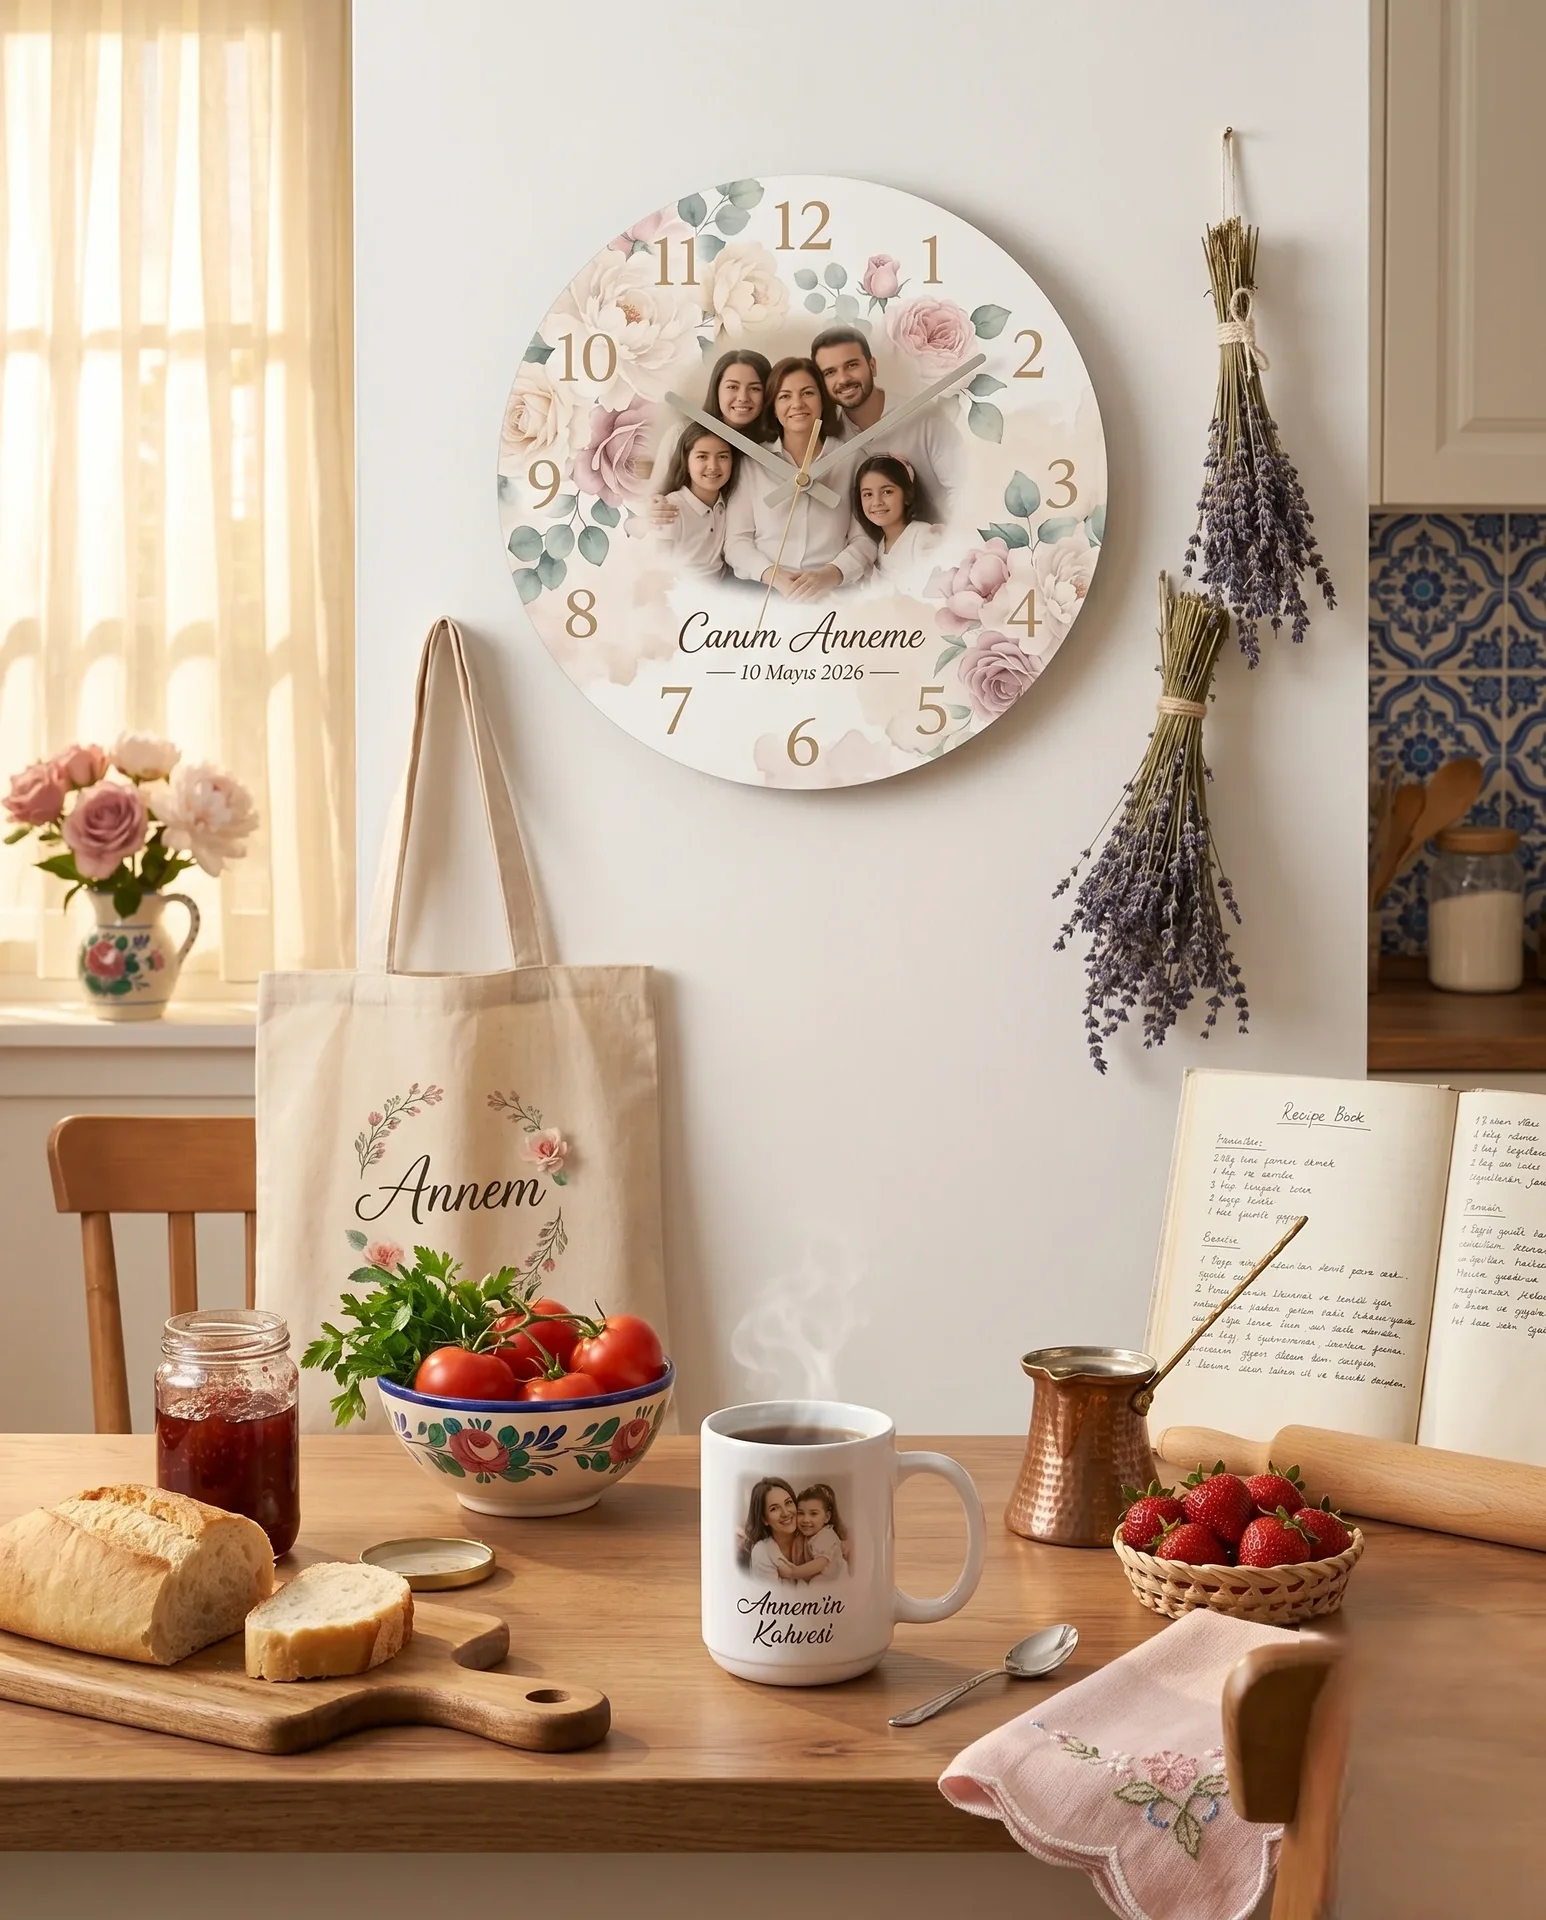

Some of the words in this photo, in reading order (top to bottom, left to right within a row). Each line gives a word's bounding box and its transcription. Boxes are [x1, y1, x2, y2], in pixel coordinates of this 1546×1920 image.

[774, 201, 833, 251] 12
[653, 237, 701, 286] 11
[921, 235, 944, 285] 1
[558, 332, 618, 382] 10
[1013, 329, 1046, 379] 2
[528, 459, 561, 510] 9
[1045, 459, 1079, 509] 3
[564, 589, 599, 639] 8
[789, 610, 926, 654] Anneme
[1007, 588, 1043, 638] 4
[740, 663, 761, 680] 10
[820, 663, 865, 680] 2026
[660, 686, 693, 735] 7
[916, 685, 948, 734] 5
[786, 718, 820, 766] 6
[1282, 1101, 1325, 1128] Recipe
[354, 1154, 547, 1225] Annem
[736, 1590, 845, 1616] Annem'in
[751, 1619, 834, 1648] Kahvesi
